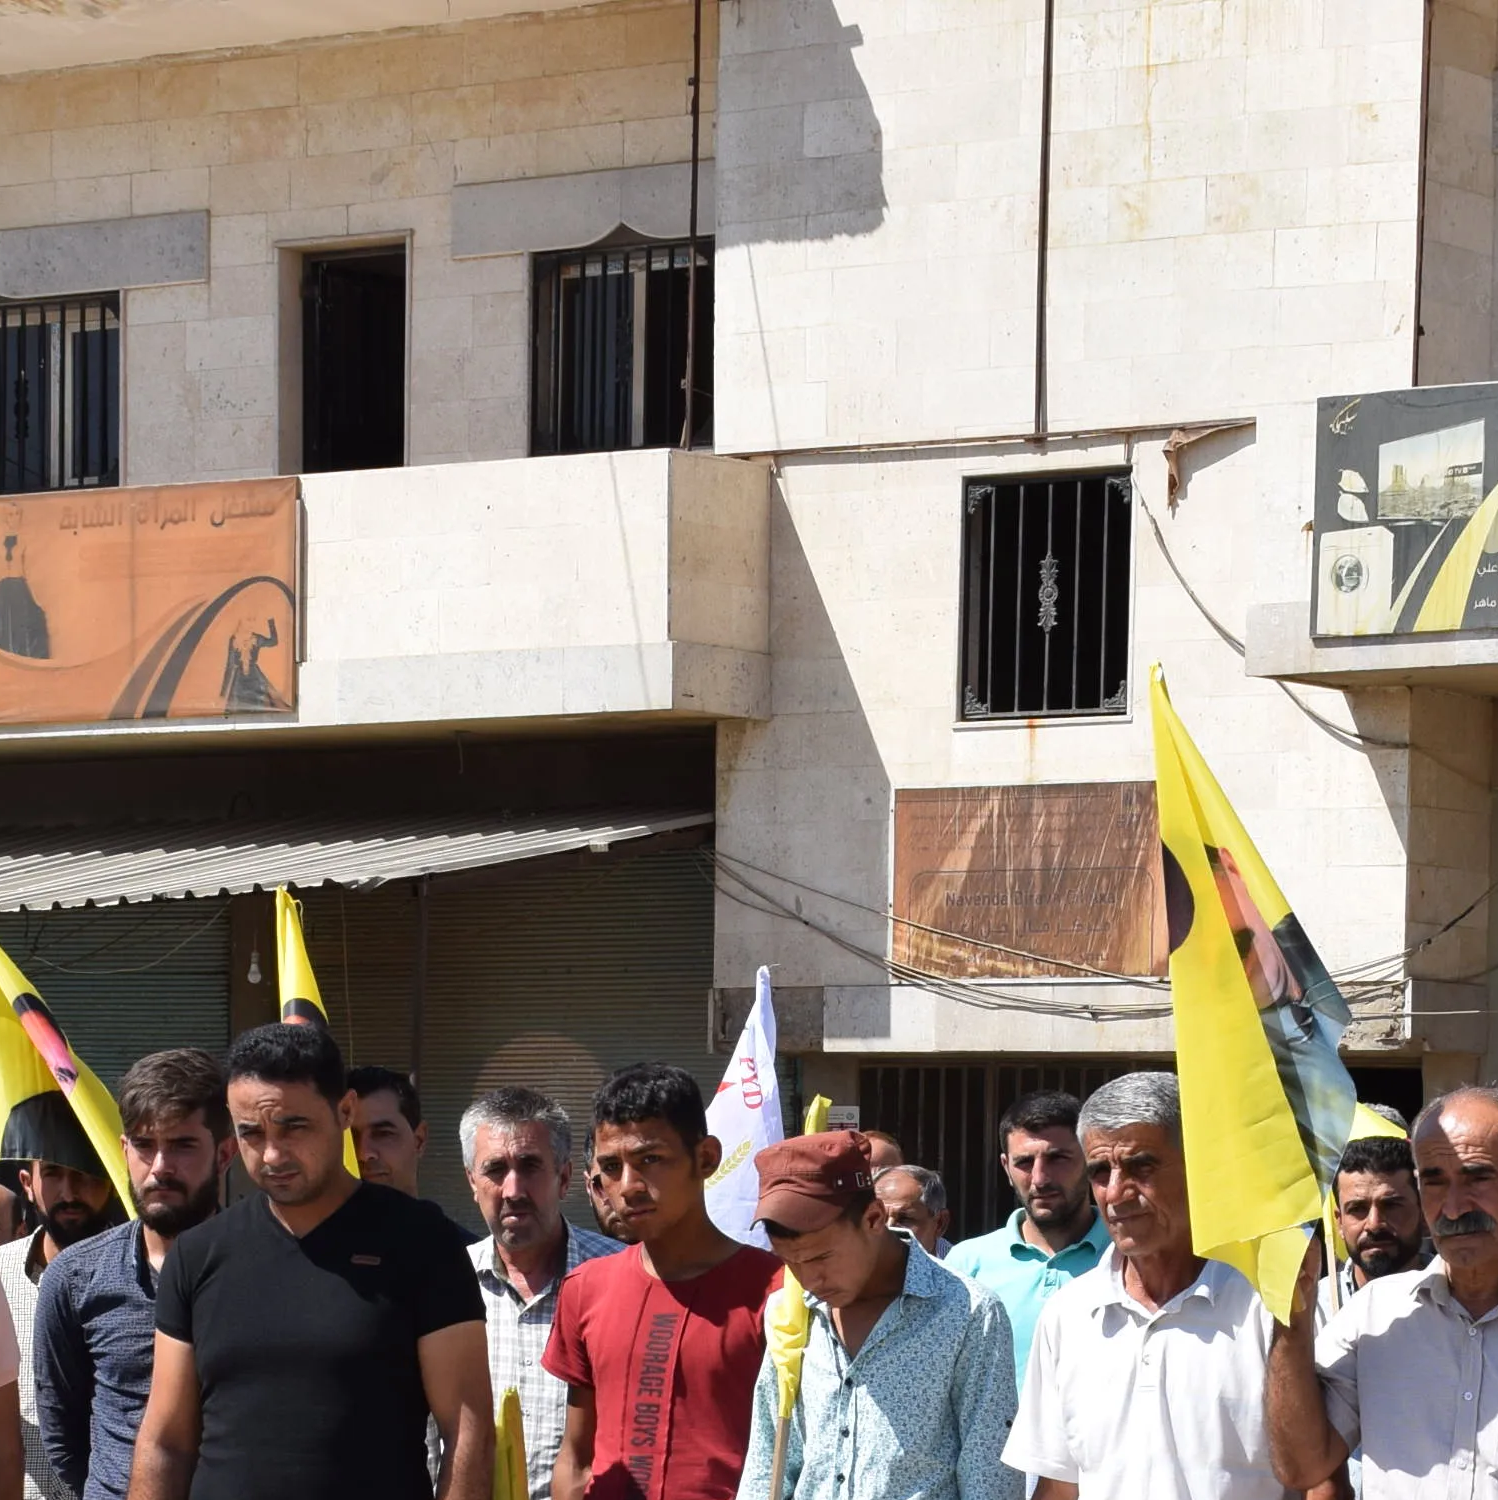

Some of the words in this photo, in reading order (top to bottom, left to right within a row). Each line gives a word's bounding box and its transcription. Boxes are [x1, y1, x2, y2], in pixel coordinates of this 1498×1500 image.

[58, 500, 124, 537] الشابة
[136, 494, 197, 531] المرأة
[739, 1056, 764, 1110] PYD
[636, 1312, 680, 1398] WOORAGE
[630, 1400, 664, 1448] BOYS
